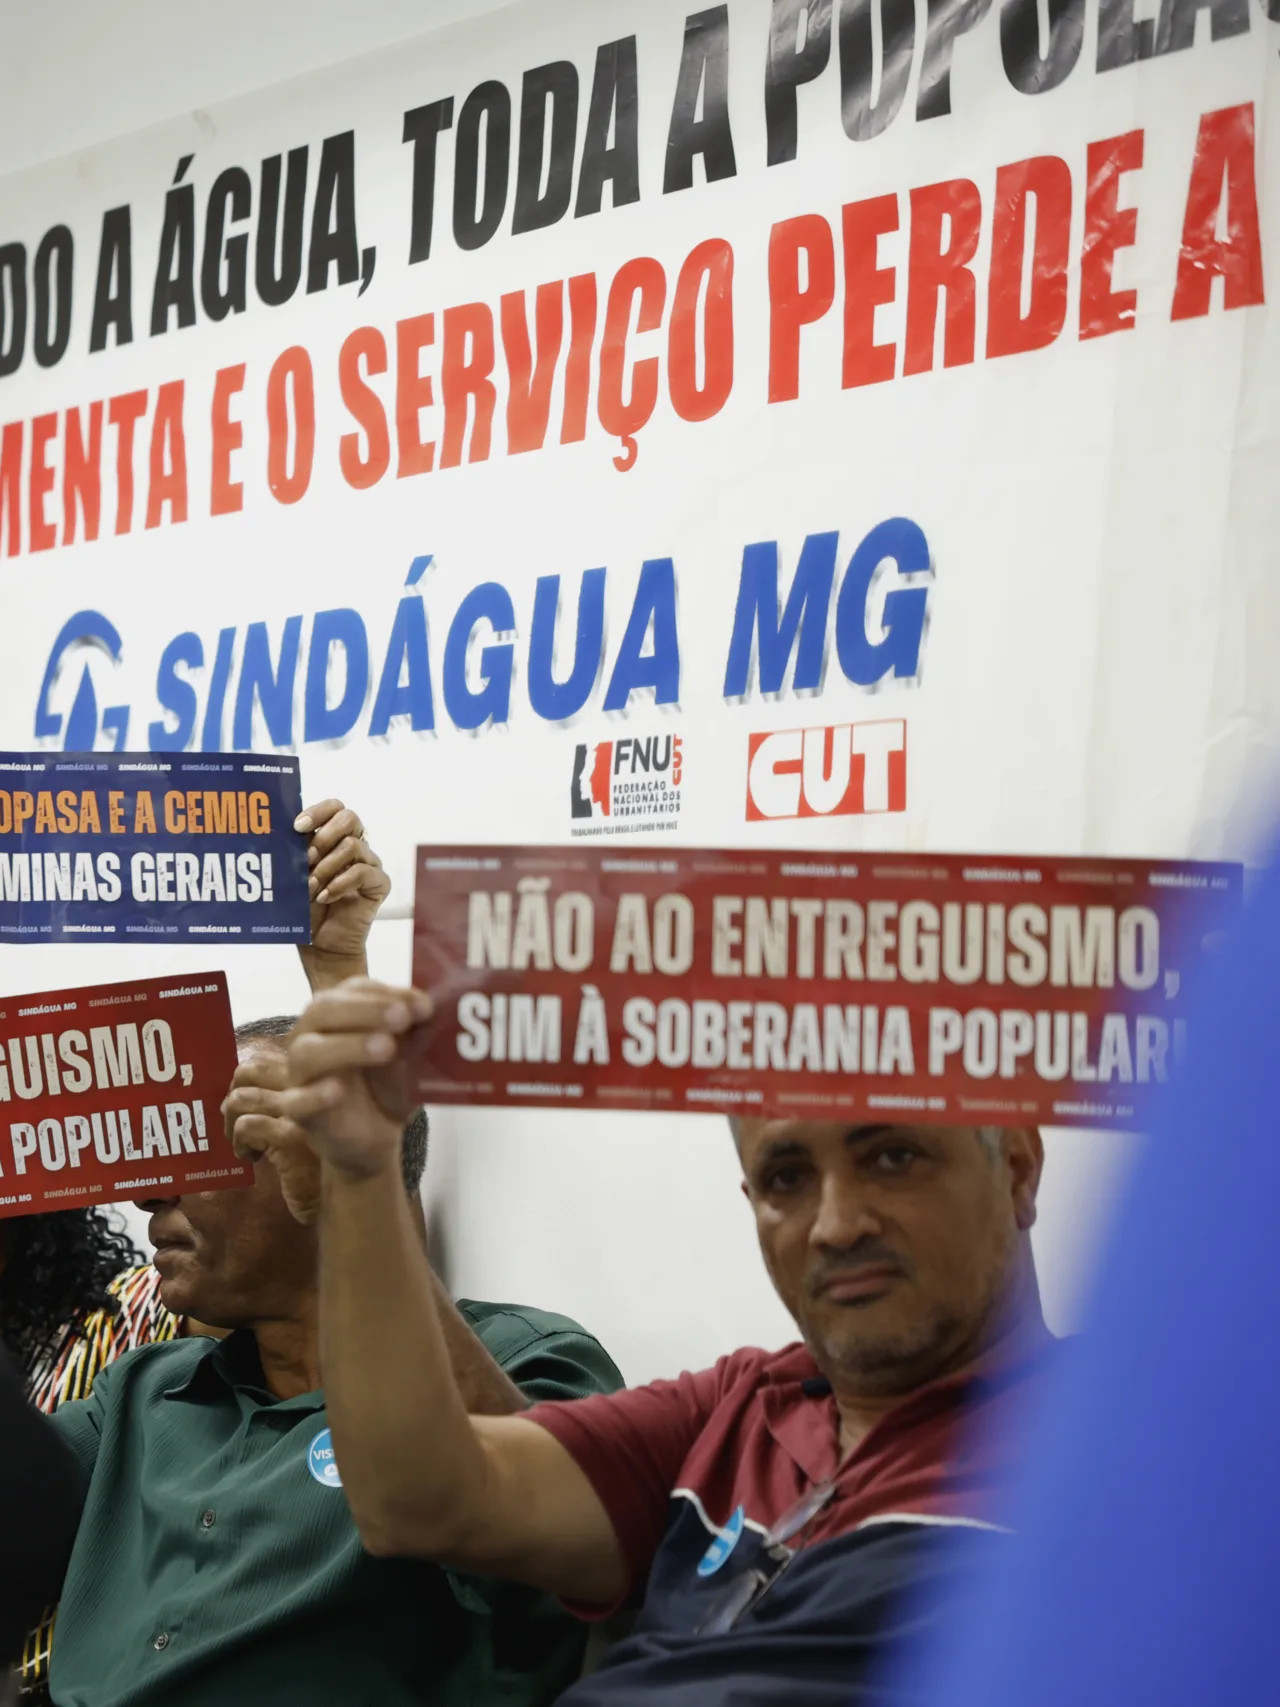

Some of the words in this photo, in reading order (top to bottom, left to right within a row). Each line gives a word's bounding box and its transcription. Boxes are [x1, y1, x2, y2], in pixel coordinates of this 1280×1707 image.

[89, 204, 133, 353] A
[150, 129, 377, 298] ÁGUA,
[402, 34, 640, 264] TODA
[662, 5, 737, 195] A
[209, 362, 246, 516] E
[266, 345, 315, 505] O
[338, 237, 735, 490] SERVIÇO
[768, 129, 1144, 405] PERDE
[1170, 101, 1265, 323] A
[148, 553, 680, 752] SINDÁGUA
[724, 516, 931, 698] MG
[118, 763, 158, 771] SINDÁGUA
[243, 764, 280, 772] SINDÁGUA
[614, 735, 671, 775] FNU
[673, 734, 683, 786] CUT
[747, 719, 906, 821] CUT
[108, 791, 126, 833] E
[134, 791, 157, 833] A
[164, 790, 271, 834] CEMIG
[613, 781, 666, 794] FEDERAÇÃO
[613, 793, 660, 805] NACIONAL
[130, 852, 273, 902] GERAIS!
[188, 925, 228, 933] SINDÁGUA
[466, 876, 594, 974] NÃO
[610, 893, 694, 976] AO
[712, 896, 1180, 999] ENTREGUISMO,
[18, 1005, 62, 1017] SINDÁGUA
[63, 1003, 76, 1011] MG
[159, 986, 203, 999] SINDÁGUA
[204, 984, 218, 993] MG
[456, 992, 561, 1063] SIM
[573, 983, 610, 1065] À
[621, 997, 915, 1073] SOBERANIA
[9, 1100, 209, 1175] POPULAR!
[18, 1194, 32, 1203] MG
[114, 1178, 158, 1191] SINDÁGUA
[159, 1176, 172, 1185] MG
